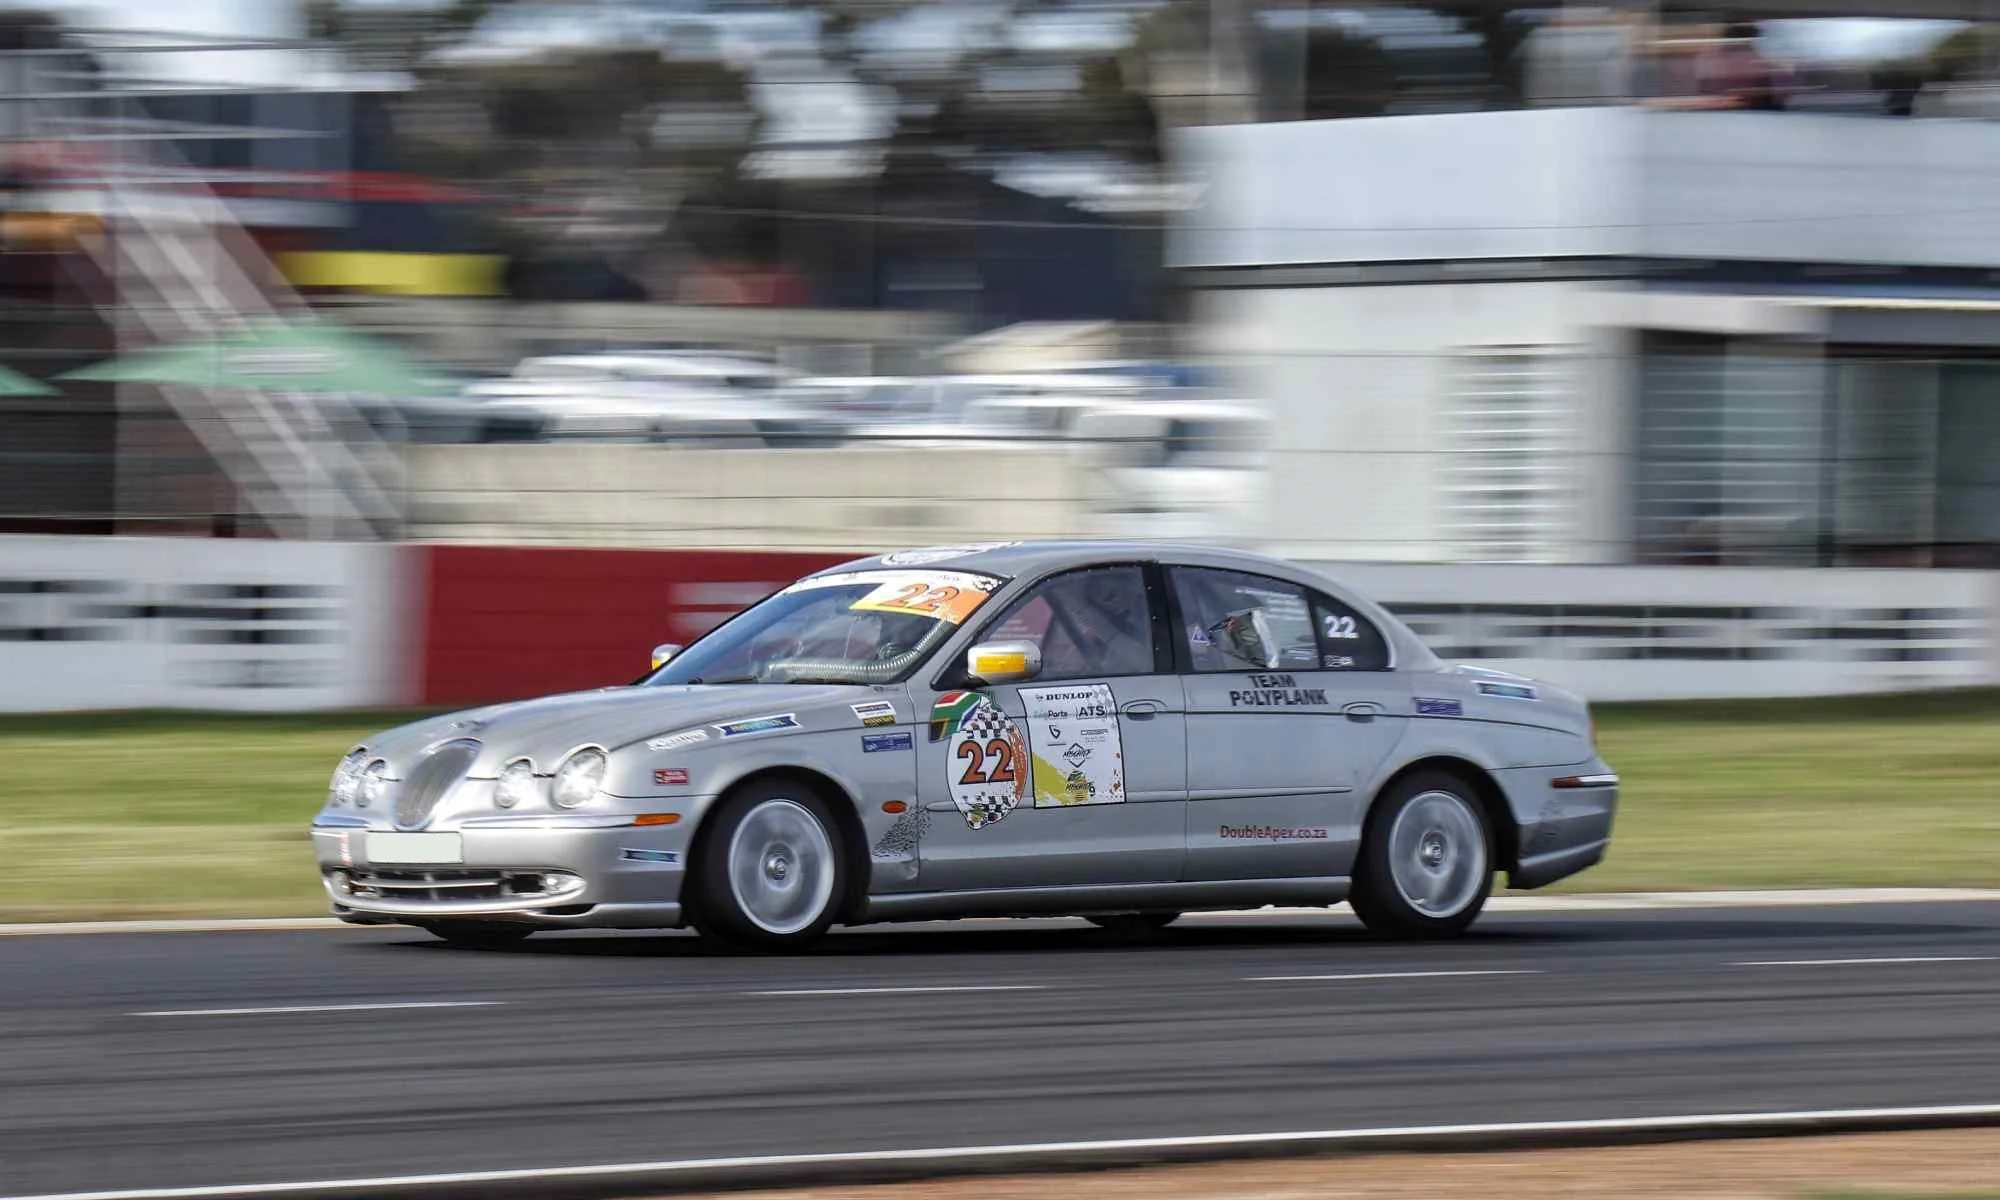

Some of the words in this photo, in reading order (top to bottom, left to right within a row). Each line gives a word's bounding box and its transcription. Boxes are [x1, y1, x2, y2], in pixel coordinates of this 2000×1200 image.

[878, 583, 960, 612] 22
[1324, 615, 1359, 639] 22
[1248, 674, 1297, 688] TEAM
[1046, 692, 1093, 701] DUNLOP
[1229, 689, 1329, 706] POLYPLANK
[1078, 705, 1106, 717] ATS
[957, 738, 1015, 785] 22
[1220, 824, 1328, 841] DoubleApex.co.za
